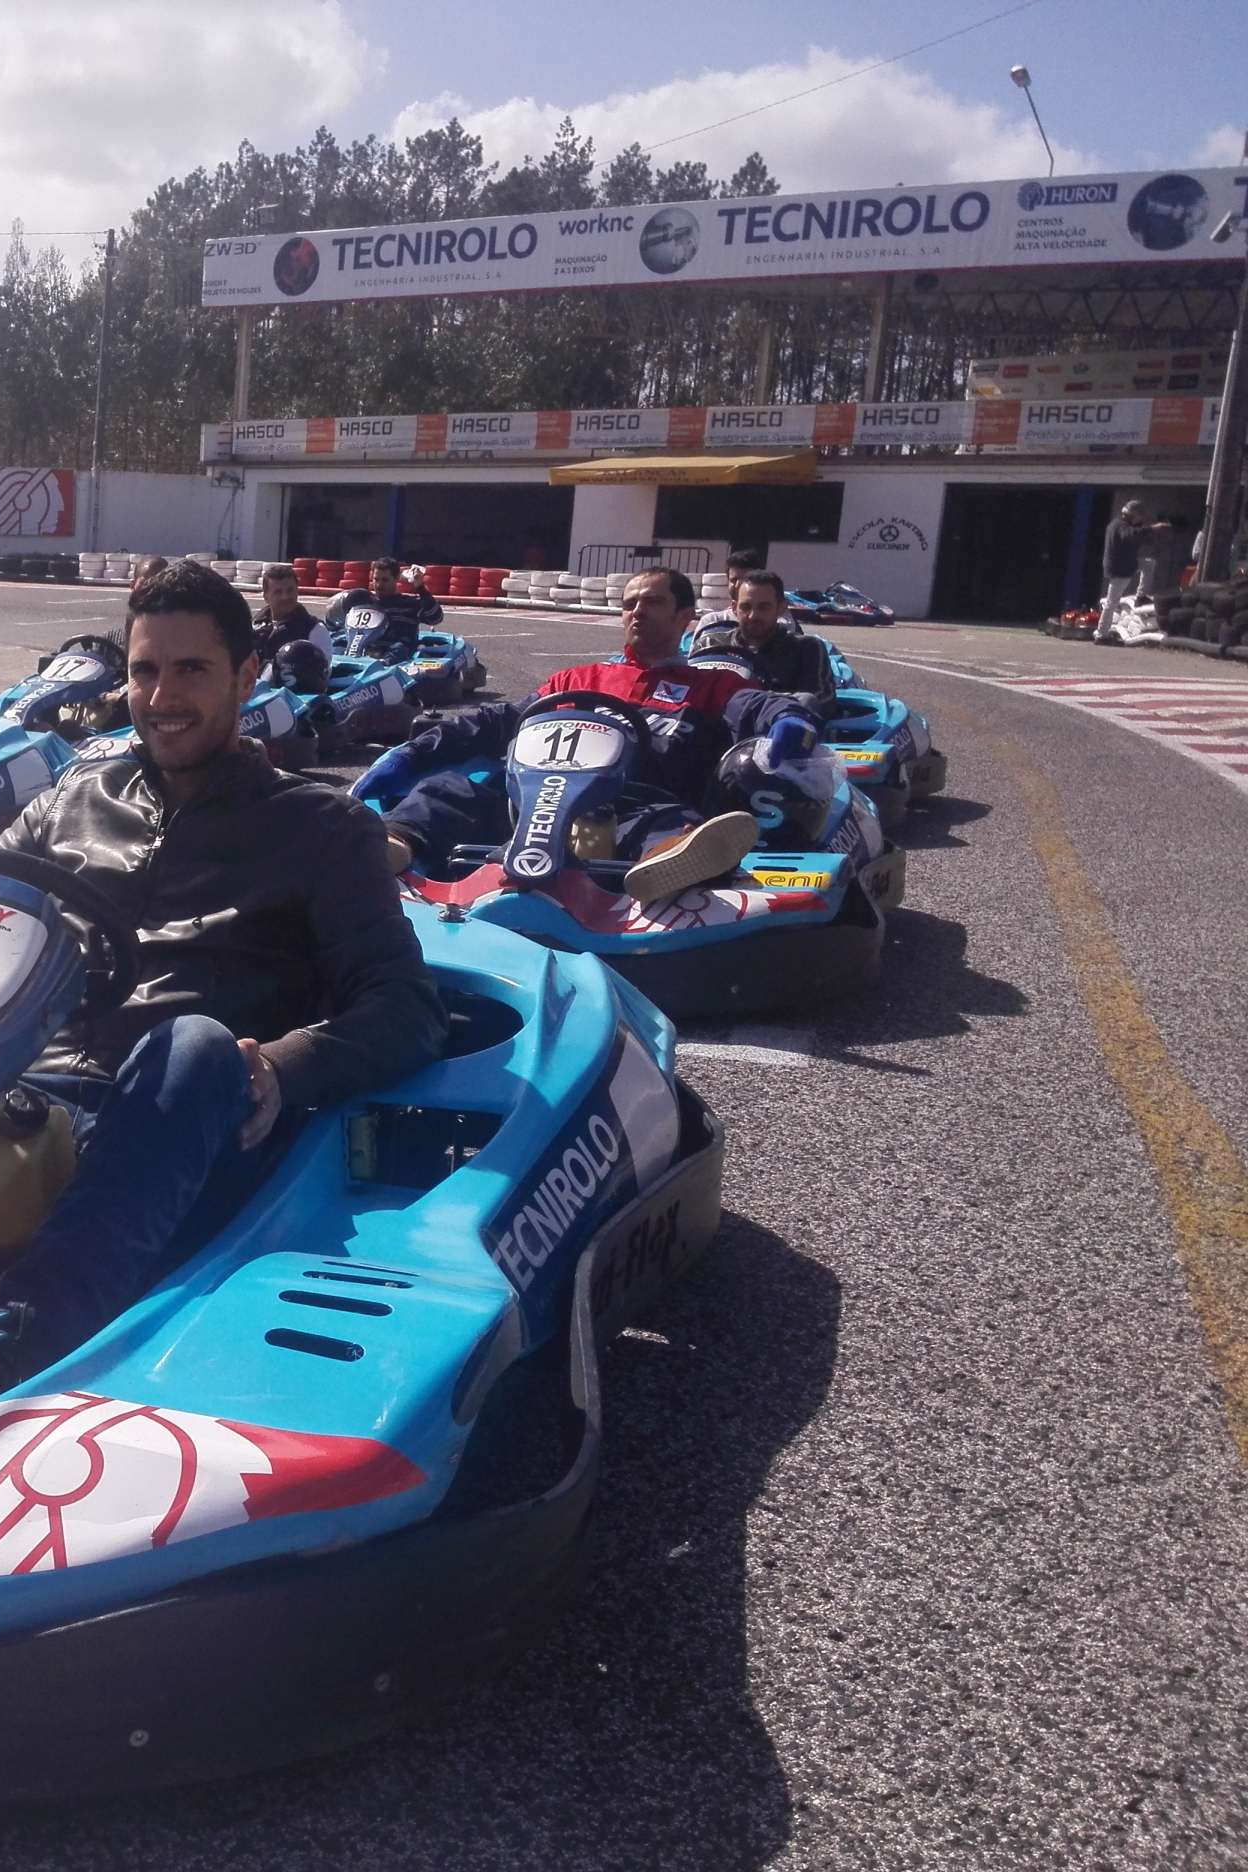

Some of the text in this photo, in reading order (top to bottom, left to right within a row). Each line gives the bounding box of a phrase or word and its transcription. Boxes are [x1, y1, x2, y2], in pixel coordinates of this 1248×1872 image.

[1051, 186, 1113, 202] HURON
[558, 213, 635, 235] worknc
[717, 191, 991, 246] TECNIROLO
[1017, 218, 1064, 228] CENTROS
[332, 223, 539, 271] TECNIROLO
[1014, 240, 1108, 250] ALTA VELOCIDADE
[576, 414, 640, 431] HASCO
[711, 411, 783, 428] HASCO
[862, 408, 940, 426] HASCO
[1027, 404, 1113, 424] HASCO
[236, 424, 285, 440] HASCO
[340, 421, 393, 437] HASCO
[452, 417, 511, 433] HASCO
[848, 518, 885, 549] ESCOLA
[354, 612, 371, 627] 19
[49, 659, 86, 678] 17
[334, 685, 379, 713] TECNIROLO
[533, 721, 611, 733] EUROINDY
[543, 728, 583, 761] 11
[525, 775, 568, 847] TECNIROLO
[750, 790, 784, 829] S
[764, 871, 825, 888] eni
